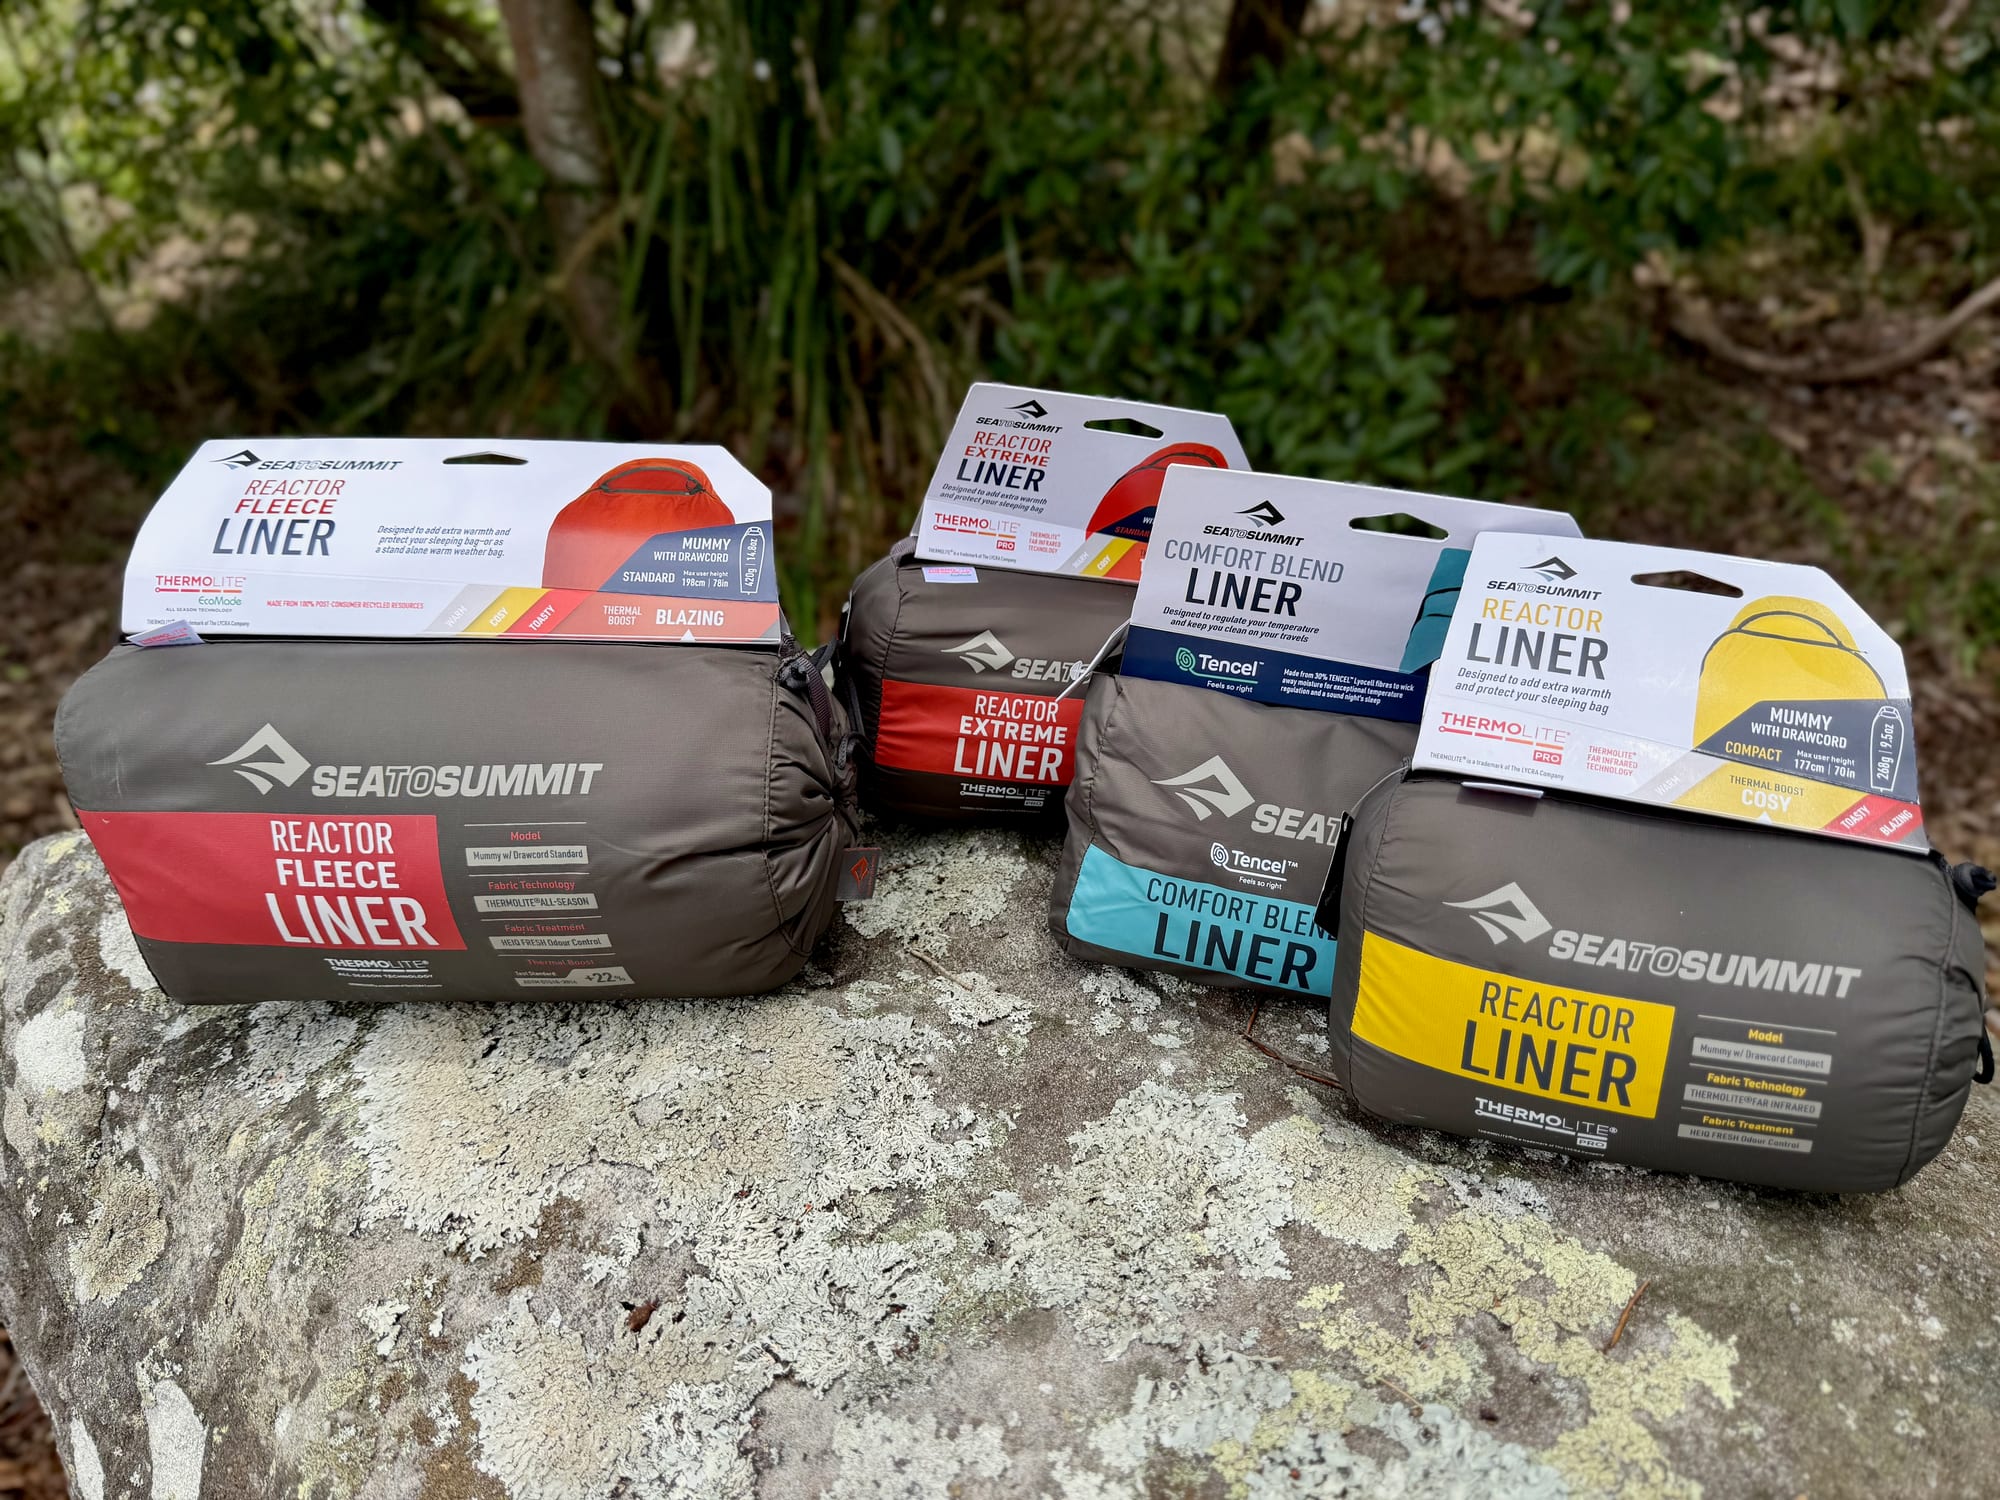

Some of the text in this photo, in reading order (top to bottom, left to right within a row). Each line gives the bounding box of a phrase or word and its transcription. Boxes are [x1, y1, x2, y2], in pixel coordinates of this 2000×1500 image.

[974, 431, 1052, 453] REACTOR
[965, 446, 1050, 467] EXTREME
[956, 459, 1045, 492] LINER
[245, 479, 345, 495] REACTOR
[942, 483, 976, 494] Designed
[986, 490, 1000, 498] add
[1020, 496, 1047, 505] warmth
[235, 498, 337, 514] FLEECE
[954, 493, 981, 503] protect
[999, 500, 1029, 512] sleeping
[1030, 504, 1044, 514] bag
[213, 518, 336, 556] LINER
[378, 526, 415, 535] Designed
[416, 526, 424, 534] to
[495, 528, 511, 536] and
[682, 537, 731, 550] MUMMY
[654, 551, 728, 562] WITH DRAWCORD
[1164, 539, 1267, 572] COMFORT
[1271, 553, 1344, 584] BLEND
[623, 572, 675, 583] STANDARD
[682, 578, 728, 587] 198cm 78in
[745, 568, 757, 587] 420g
[198, 596, 242, 605] EcoMade
[1185, 567, 1303, 617] LINER
[528, 605, 555, 631] TOASTY
[603, 605, 642, 615] THERMAL
[608, 615, 636, 626] BOOST
[656, 609, 724, 626] BLAZING
[1163, 606, 1319, 634] Designed to regulate your temperature
[1482, 597, 1603, 633] REACTOR
[1171, 619, 1185, 627] and
[1187, 620, 1207, 631] keep
[1208, 624, 1222, 633] you
[1225, 626, 1246, 635] clean
[1259, 630, 1278, 638] your
[1279, 631, 1309, 643] travels
[1467, 623, 1609, 680] LINER
[1207, 680, 1225, 689] Feels
[1236, 685, 1253, 693] right
[1298, 679, 1323, 689] moisture
[1333, 684, 1367, 694] exceptional
[1368, 688, 1403, 698] temperature
[1458, 668, 1611, 699] Designed to add extra warmth
[975, 694, 1059, 722] REACTOR
[1455, 681, 1609, 715] and protect your sleeping bag
[1770, 707, 1832, 731] MUMMY
[960, 716, 1068, 745] EXTREME
[1751, 722, 1847, 749] WITH DRAWCORD
[1880, 724, 1894, 748] 9.5oz
[953, 738, 1063, 781] LINER
[1535, 753, 1560, 763] PRO
[1588, 754, 1637, 768] FAR INFRARED
[1725, 741, 1782, 762] COMPACT
[1797, 750, 1812, 758] Max
[1831, 756, 1855, 766] height
[1587, 763, 1633, 776] TECHNOLOGY
[1795, 759, 1855, 778] 177cm 70in
[1877, 757, 1894, 780] 268g
[1730, 775, 1805, 796] THERMAL BOOST
[1741, 788, 1792, 813] COSY
[1840, 805, 1870, 830] TOASTY
[1879, 809, 1913, 837] BLAZING
[270, 820, 394, 854] REACTOR
[511, 832, 541, 840] Model
[473, 850, 583, 861] Mummy w/ Drawcord Standard
[275, 859, 400, 889] FLEECE
[1239, 876, 1256, 886] Feels
[1267, 881, 1281, 890] right
[488, 881, 575, 891] Fabric Technology
[1147, 878, 1258, 924] COMFORT
[265, 893, 440, 946] LINER
[1153, 912, 1317, 989] LINER
[1479, 981, 1635, 1044] REACTOR
[1748, 1029, 1783, 1043] Model
[1461, 1019, 1637, 1108] LINER
[1700, 1043, 1824, 1069] Mummy w/ Drawcord Compact
[1707, 1073, 1806, 1096] Fabric Technology
[1703, 1116, 1794, 1135] Fabric Treatment
[1690, 1129, 1800, 1149] HEIQ FRESH Odour Control
